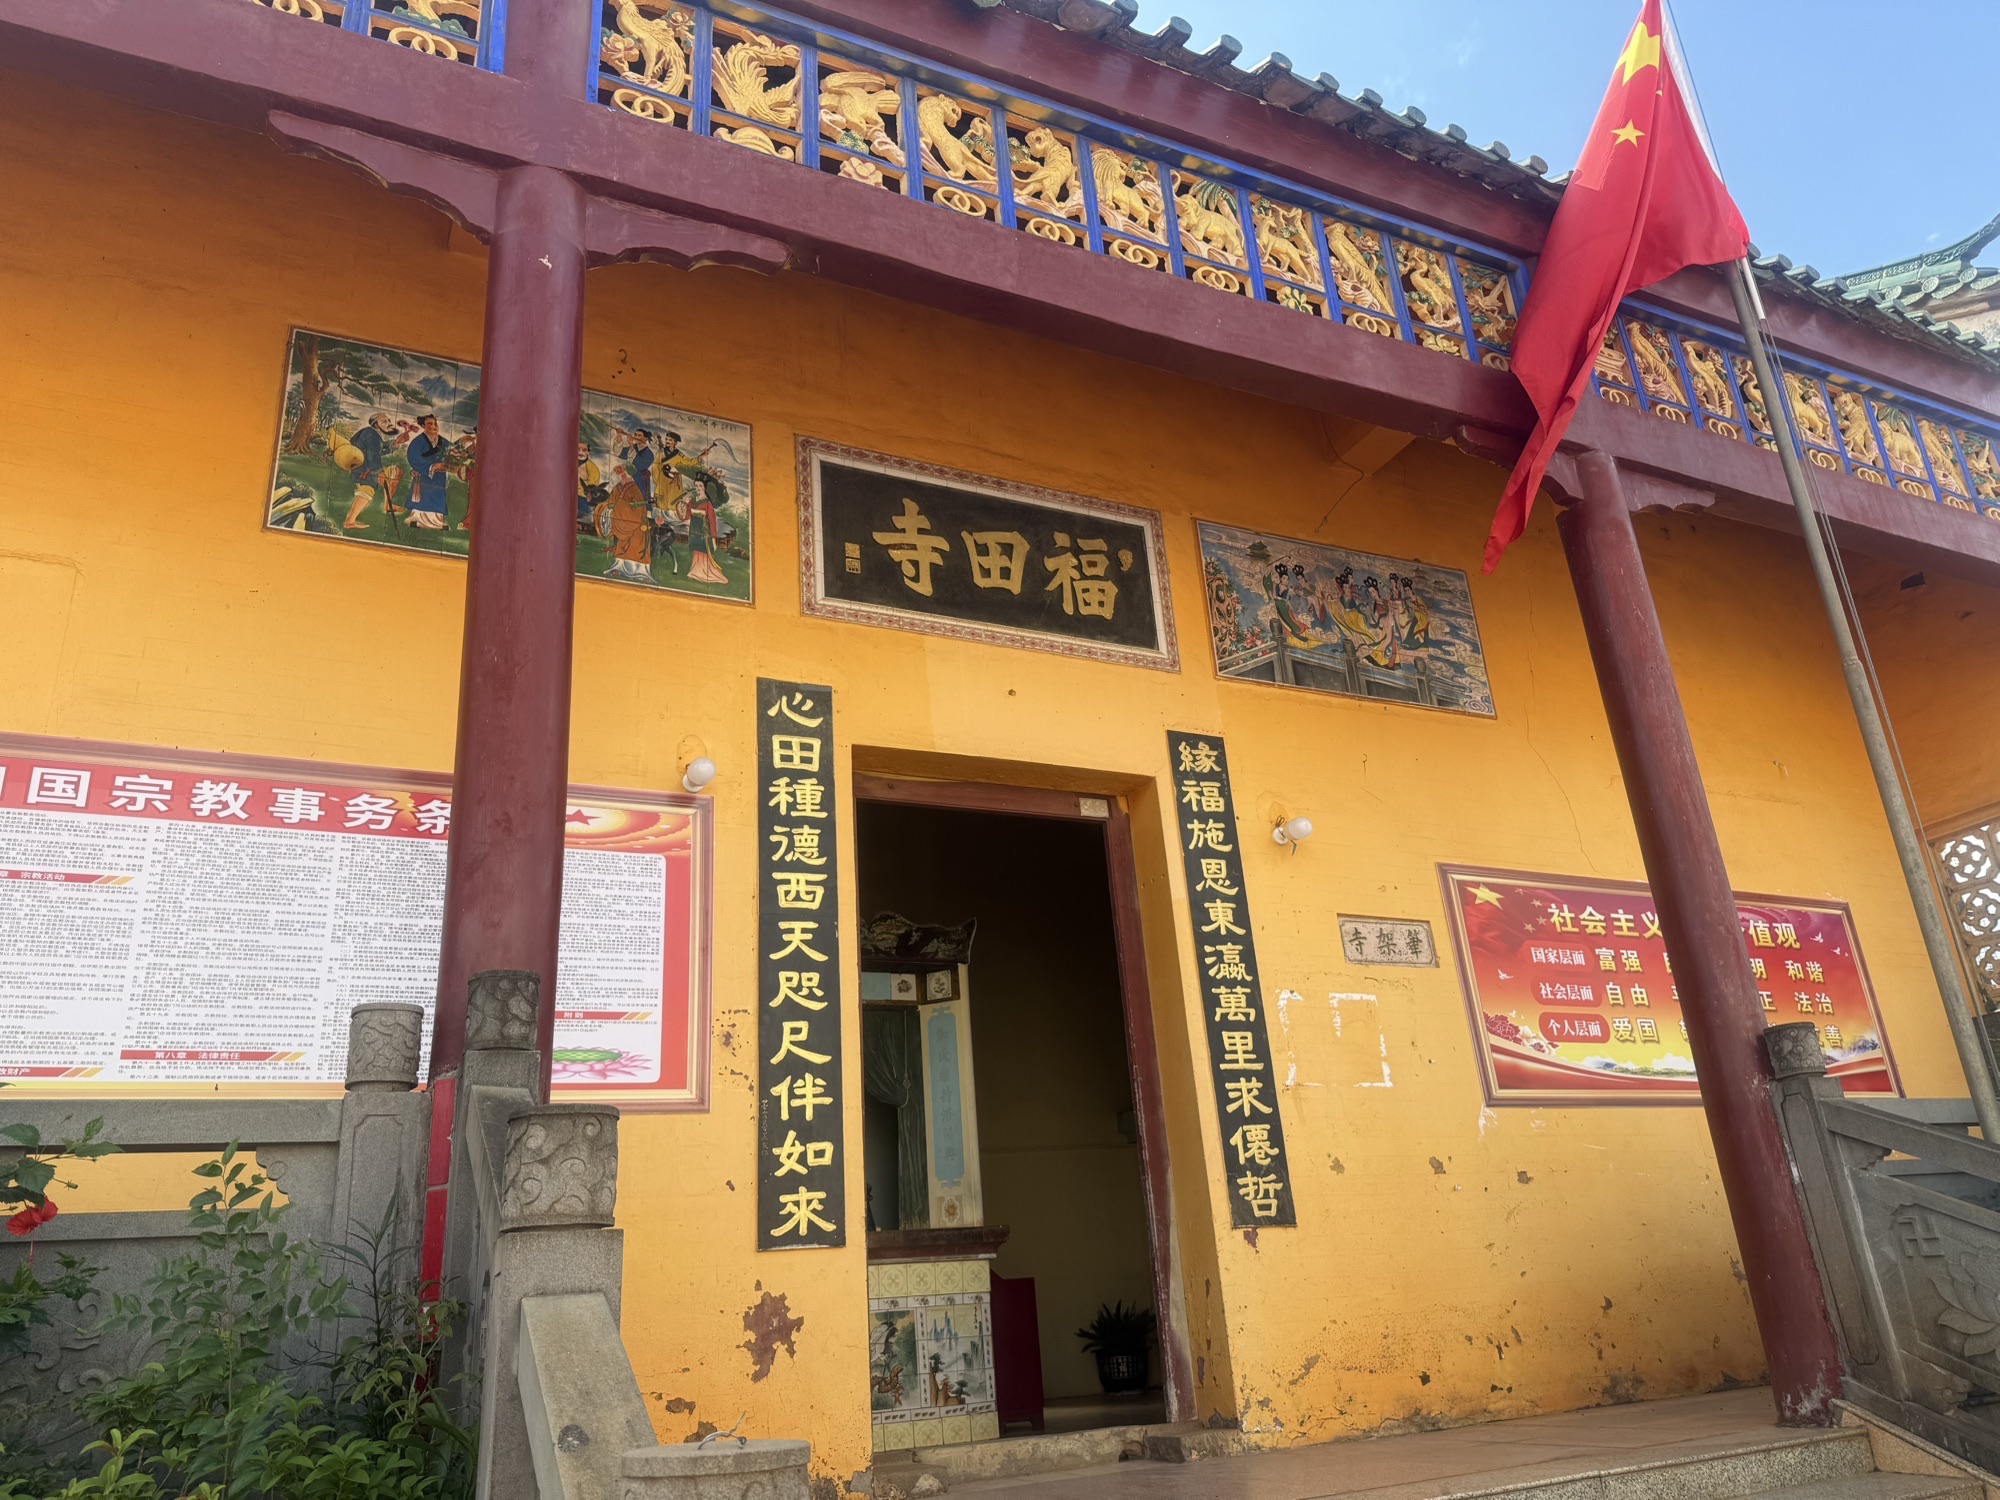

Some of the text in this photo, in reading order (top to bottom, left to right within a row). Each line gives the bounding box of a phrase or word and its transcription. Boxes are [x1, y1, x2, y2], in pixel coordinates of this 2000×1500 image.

[872, 498, 1118, 620] 福田寺
[0, 766, 452, 835] 国宗教事务条
[1348, 927, 1423, 960] 筆架寺
[1547, 903, 1801, 949] 社会主义 值观
[1531, 947, 1586, 966] 国家层面
[1595, 947, 1643, 973] 富强
[1785, 960, 1825, 984] 和谐
[1539, 982, 1594, 1001] 社会层面
[1606, 981, 1649, 1007] 自由
[1794, 991, 1834, 1014] 法治
[1548, 1019, 1602, 1037] 个人层面
[1612, 1017, 1659, 1042] 爱国
[154, 1052, 187, 1060] 第八章
